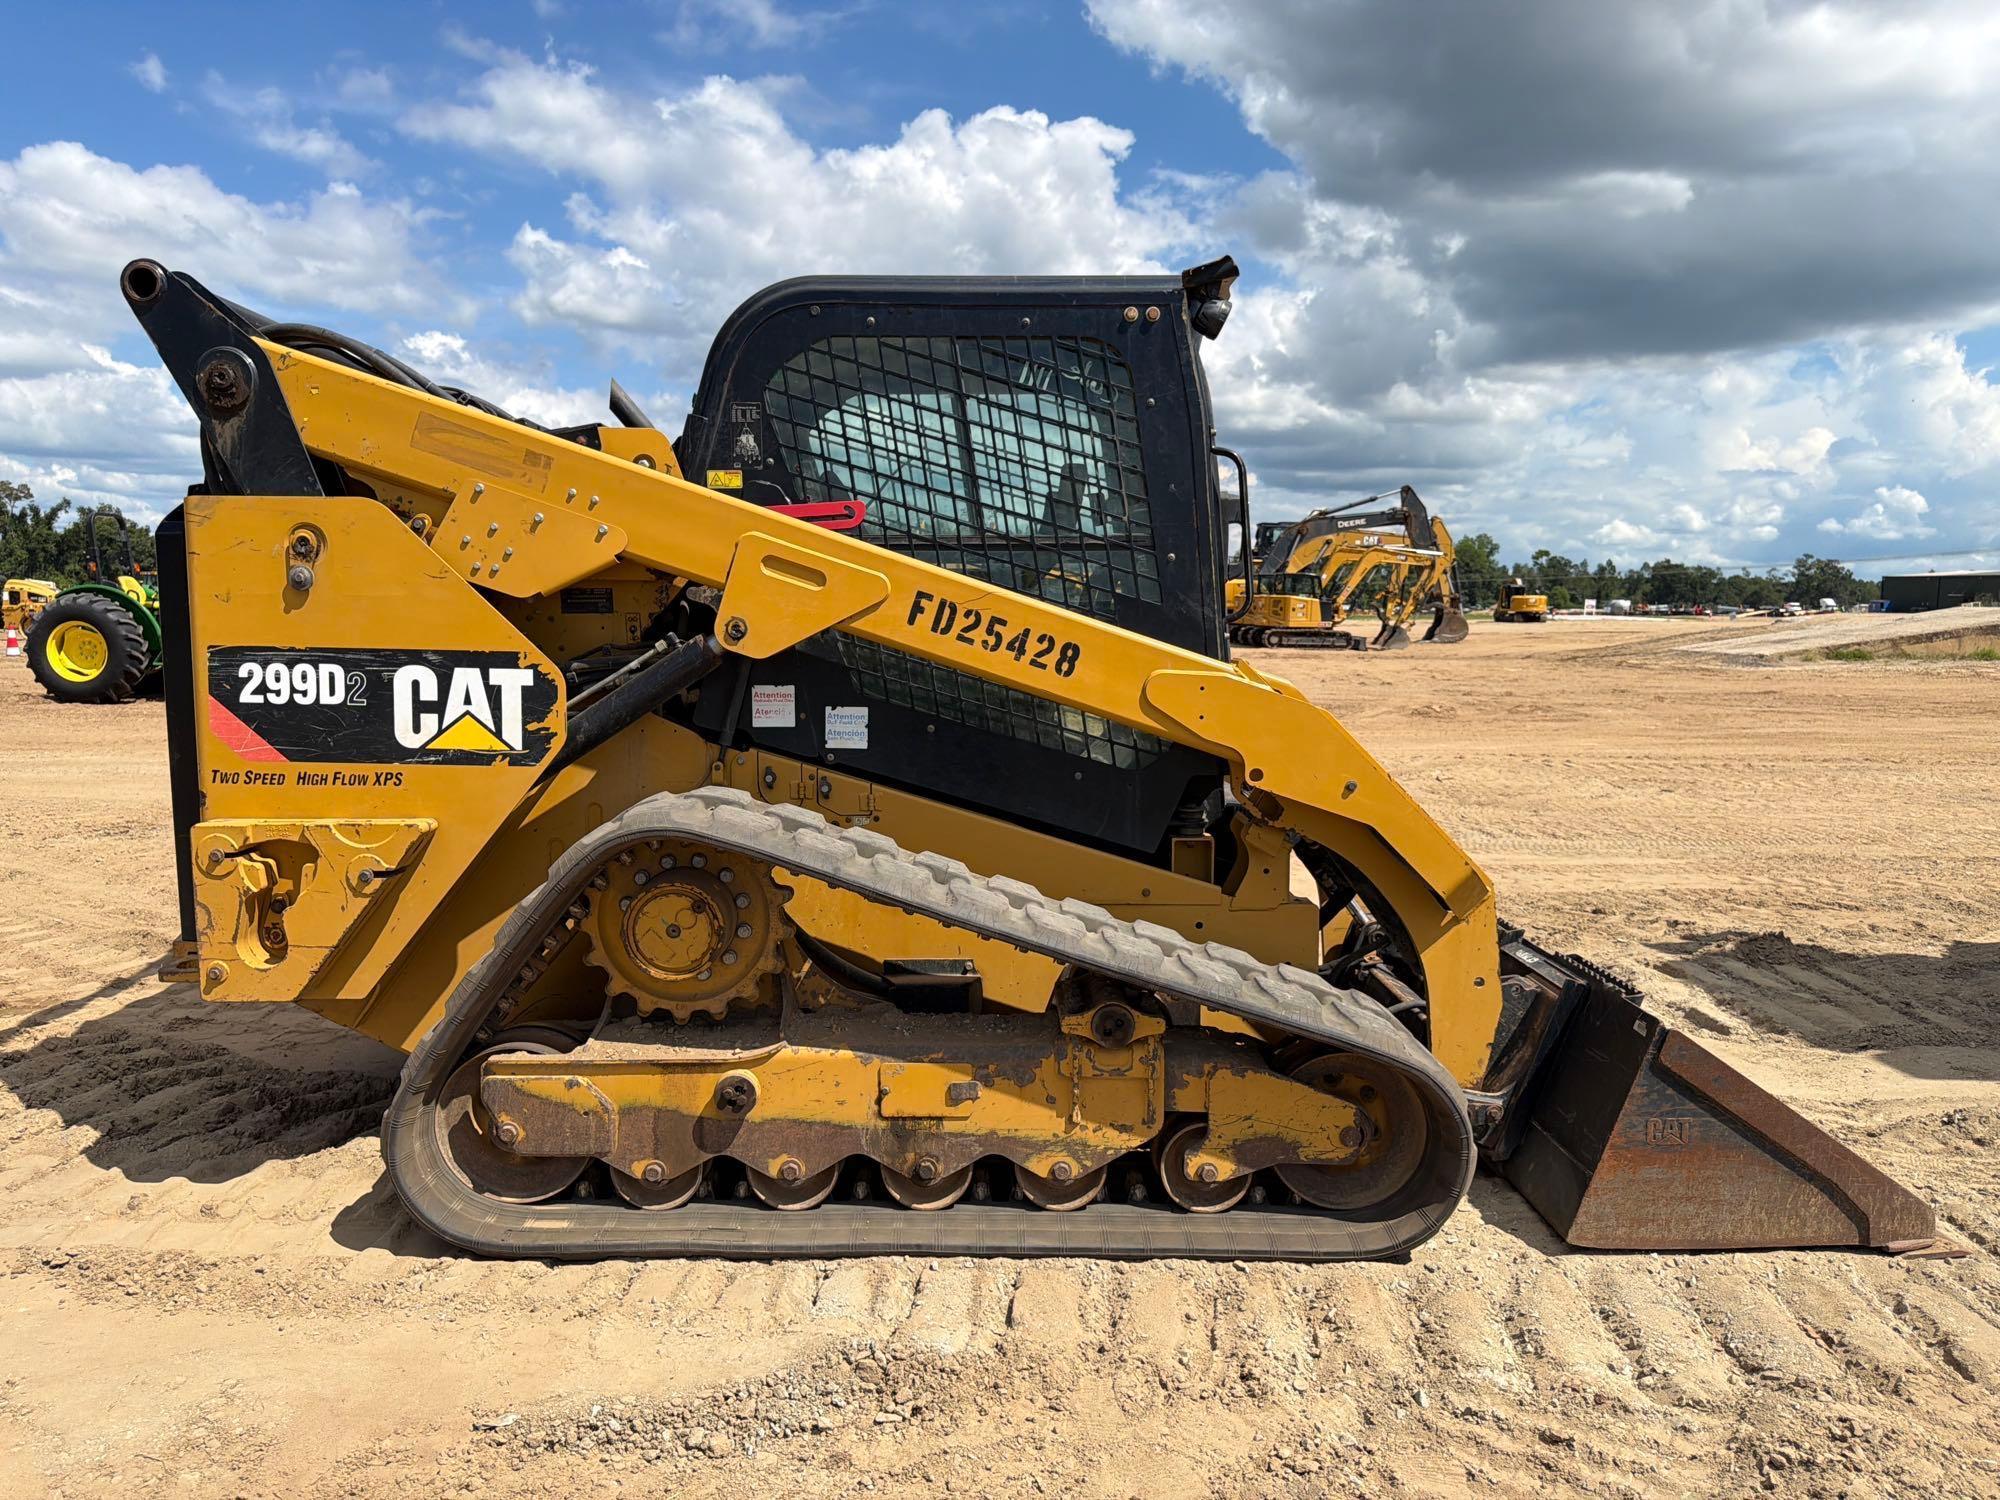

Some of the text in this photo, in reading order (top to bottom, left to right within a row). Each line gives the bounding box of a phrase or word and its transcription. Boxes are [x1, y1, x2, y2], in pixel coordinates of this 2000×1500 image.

[1337, 518, 1367, 528] DEERE
[1363, 536, 1379, 545] CAT
[906, 590, 1081, 678] FD25428
[238, 662, 367, 706] 299D2
[753, 691, 792, 699] Attention
[393, 664, 534, 750] CAT
[827, 728, 865, 736] Atención
[373, 771, 404, 787] XPS
[1646, 1117, 1693, 1145] CAT
